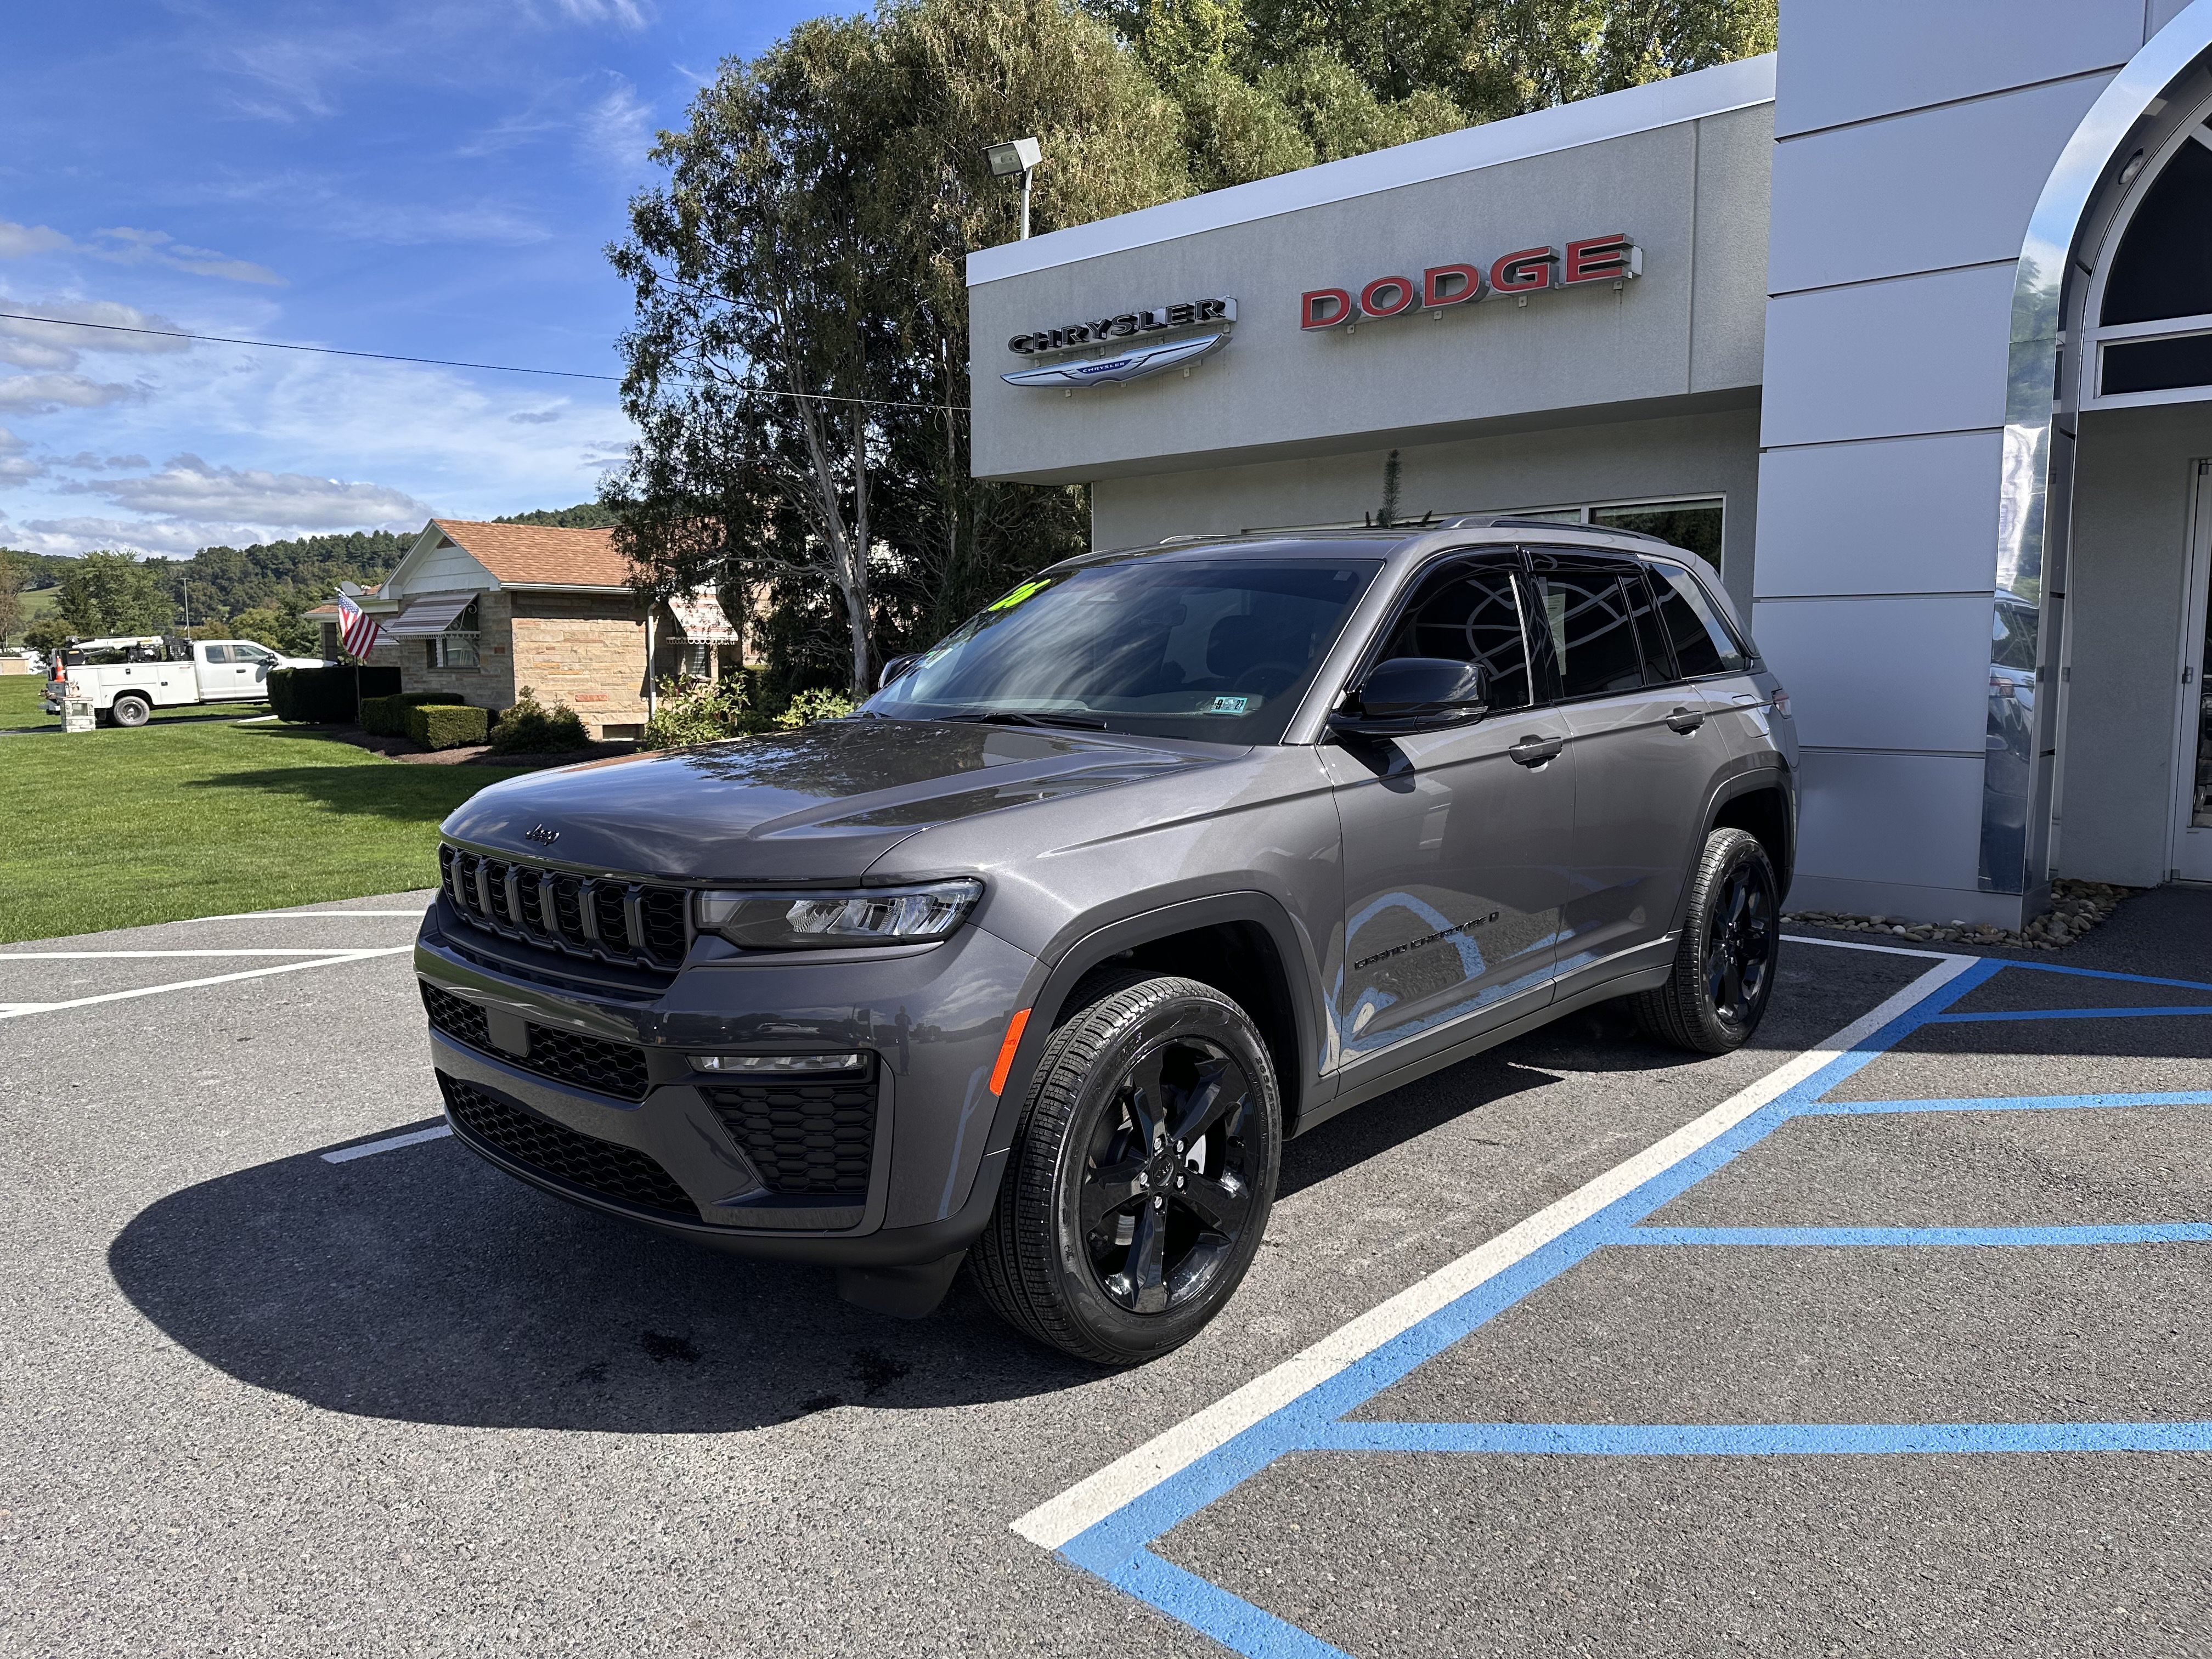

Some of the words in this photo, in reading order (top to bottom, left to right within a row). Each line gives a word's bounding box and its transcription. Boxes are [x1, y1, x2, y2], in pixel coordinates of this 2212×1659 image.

[1301, 233, 1630, 330] DODGE
[1008, 298, 1226, 354] CHRYSLER
[1082, 362, 1125, 373] CHRYSLER
[1215, 699, 1223, 710] 9
[1234, 699, 1245, 710] 27
[525, 823, 560, 846] Jeep
